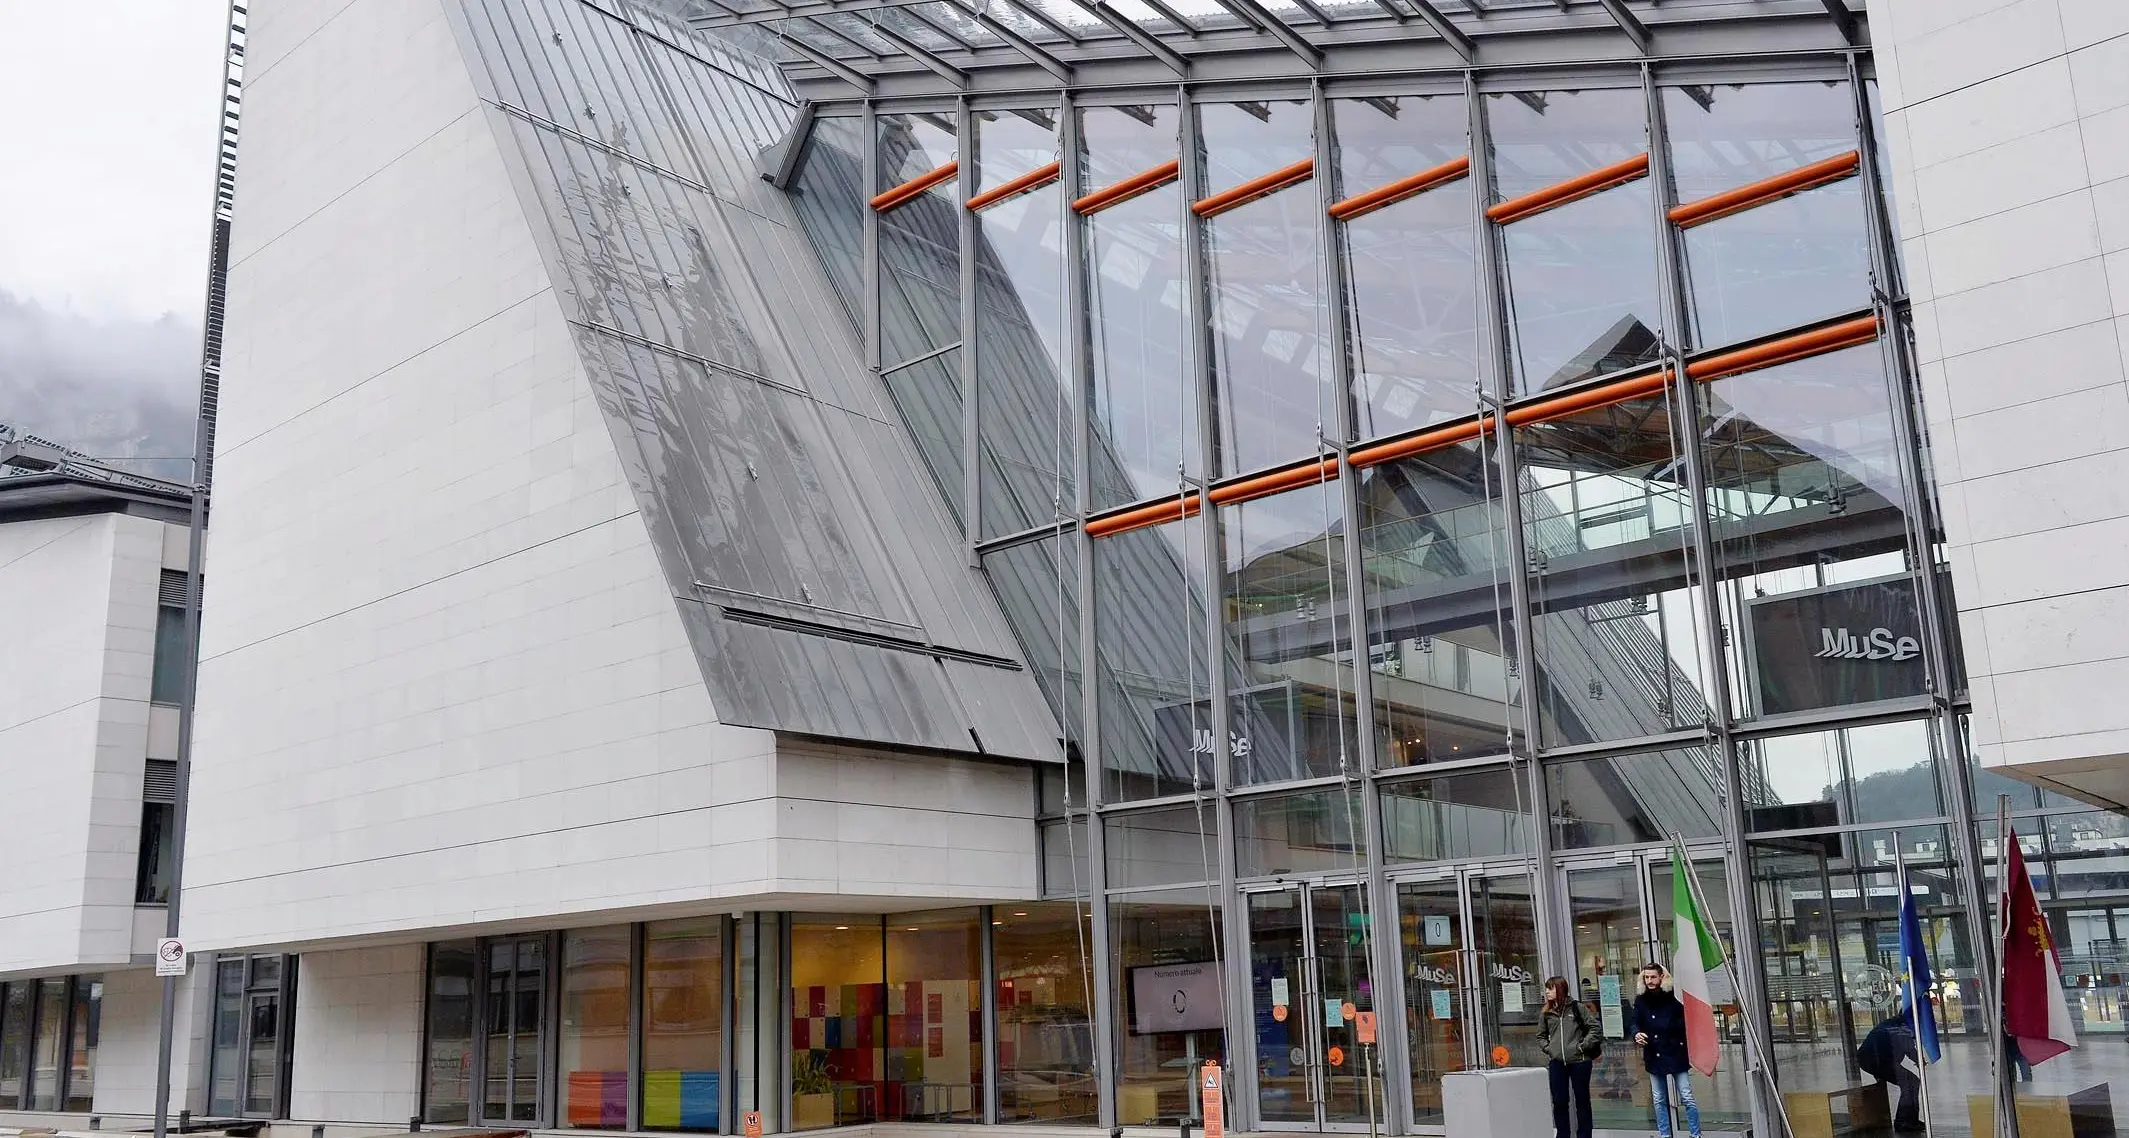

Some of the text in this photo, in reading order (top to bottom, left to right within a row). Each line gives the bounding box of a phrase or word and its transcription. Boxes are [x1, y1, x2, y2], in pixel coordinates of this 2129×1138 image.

[1813, 627, 1920, 661] MuSe
[1415, 964, 1457, 984] MuSe
[1489, 962, 1533, 983] MuSe
